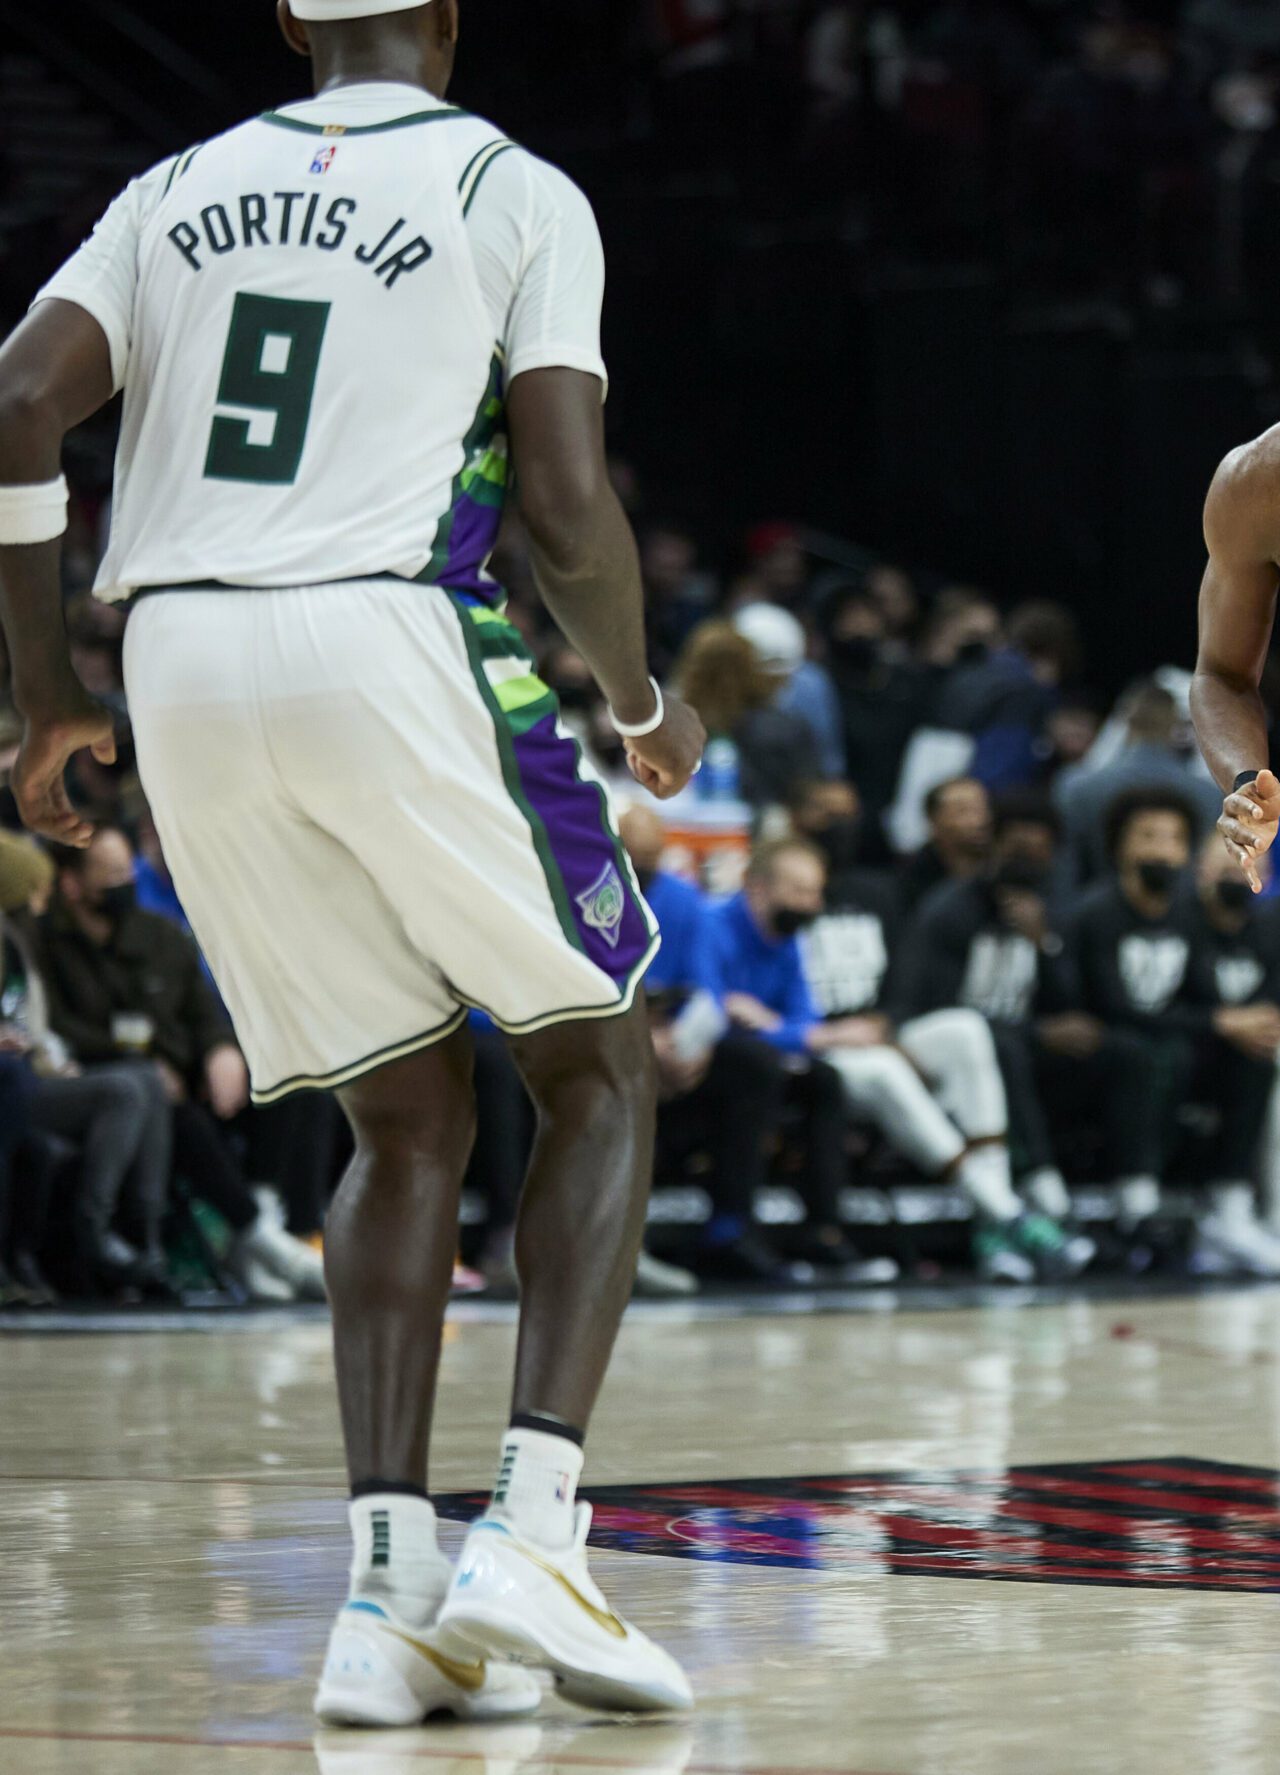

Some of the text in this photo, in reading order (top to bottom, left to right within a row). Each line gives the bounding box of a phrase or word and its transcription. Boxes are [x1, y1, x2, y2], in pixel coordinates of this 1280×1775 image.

[167, 191, 433, 290] PORTIS JR
[203, 290, 333, 486] 9
